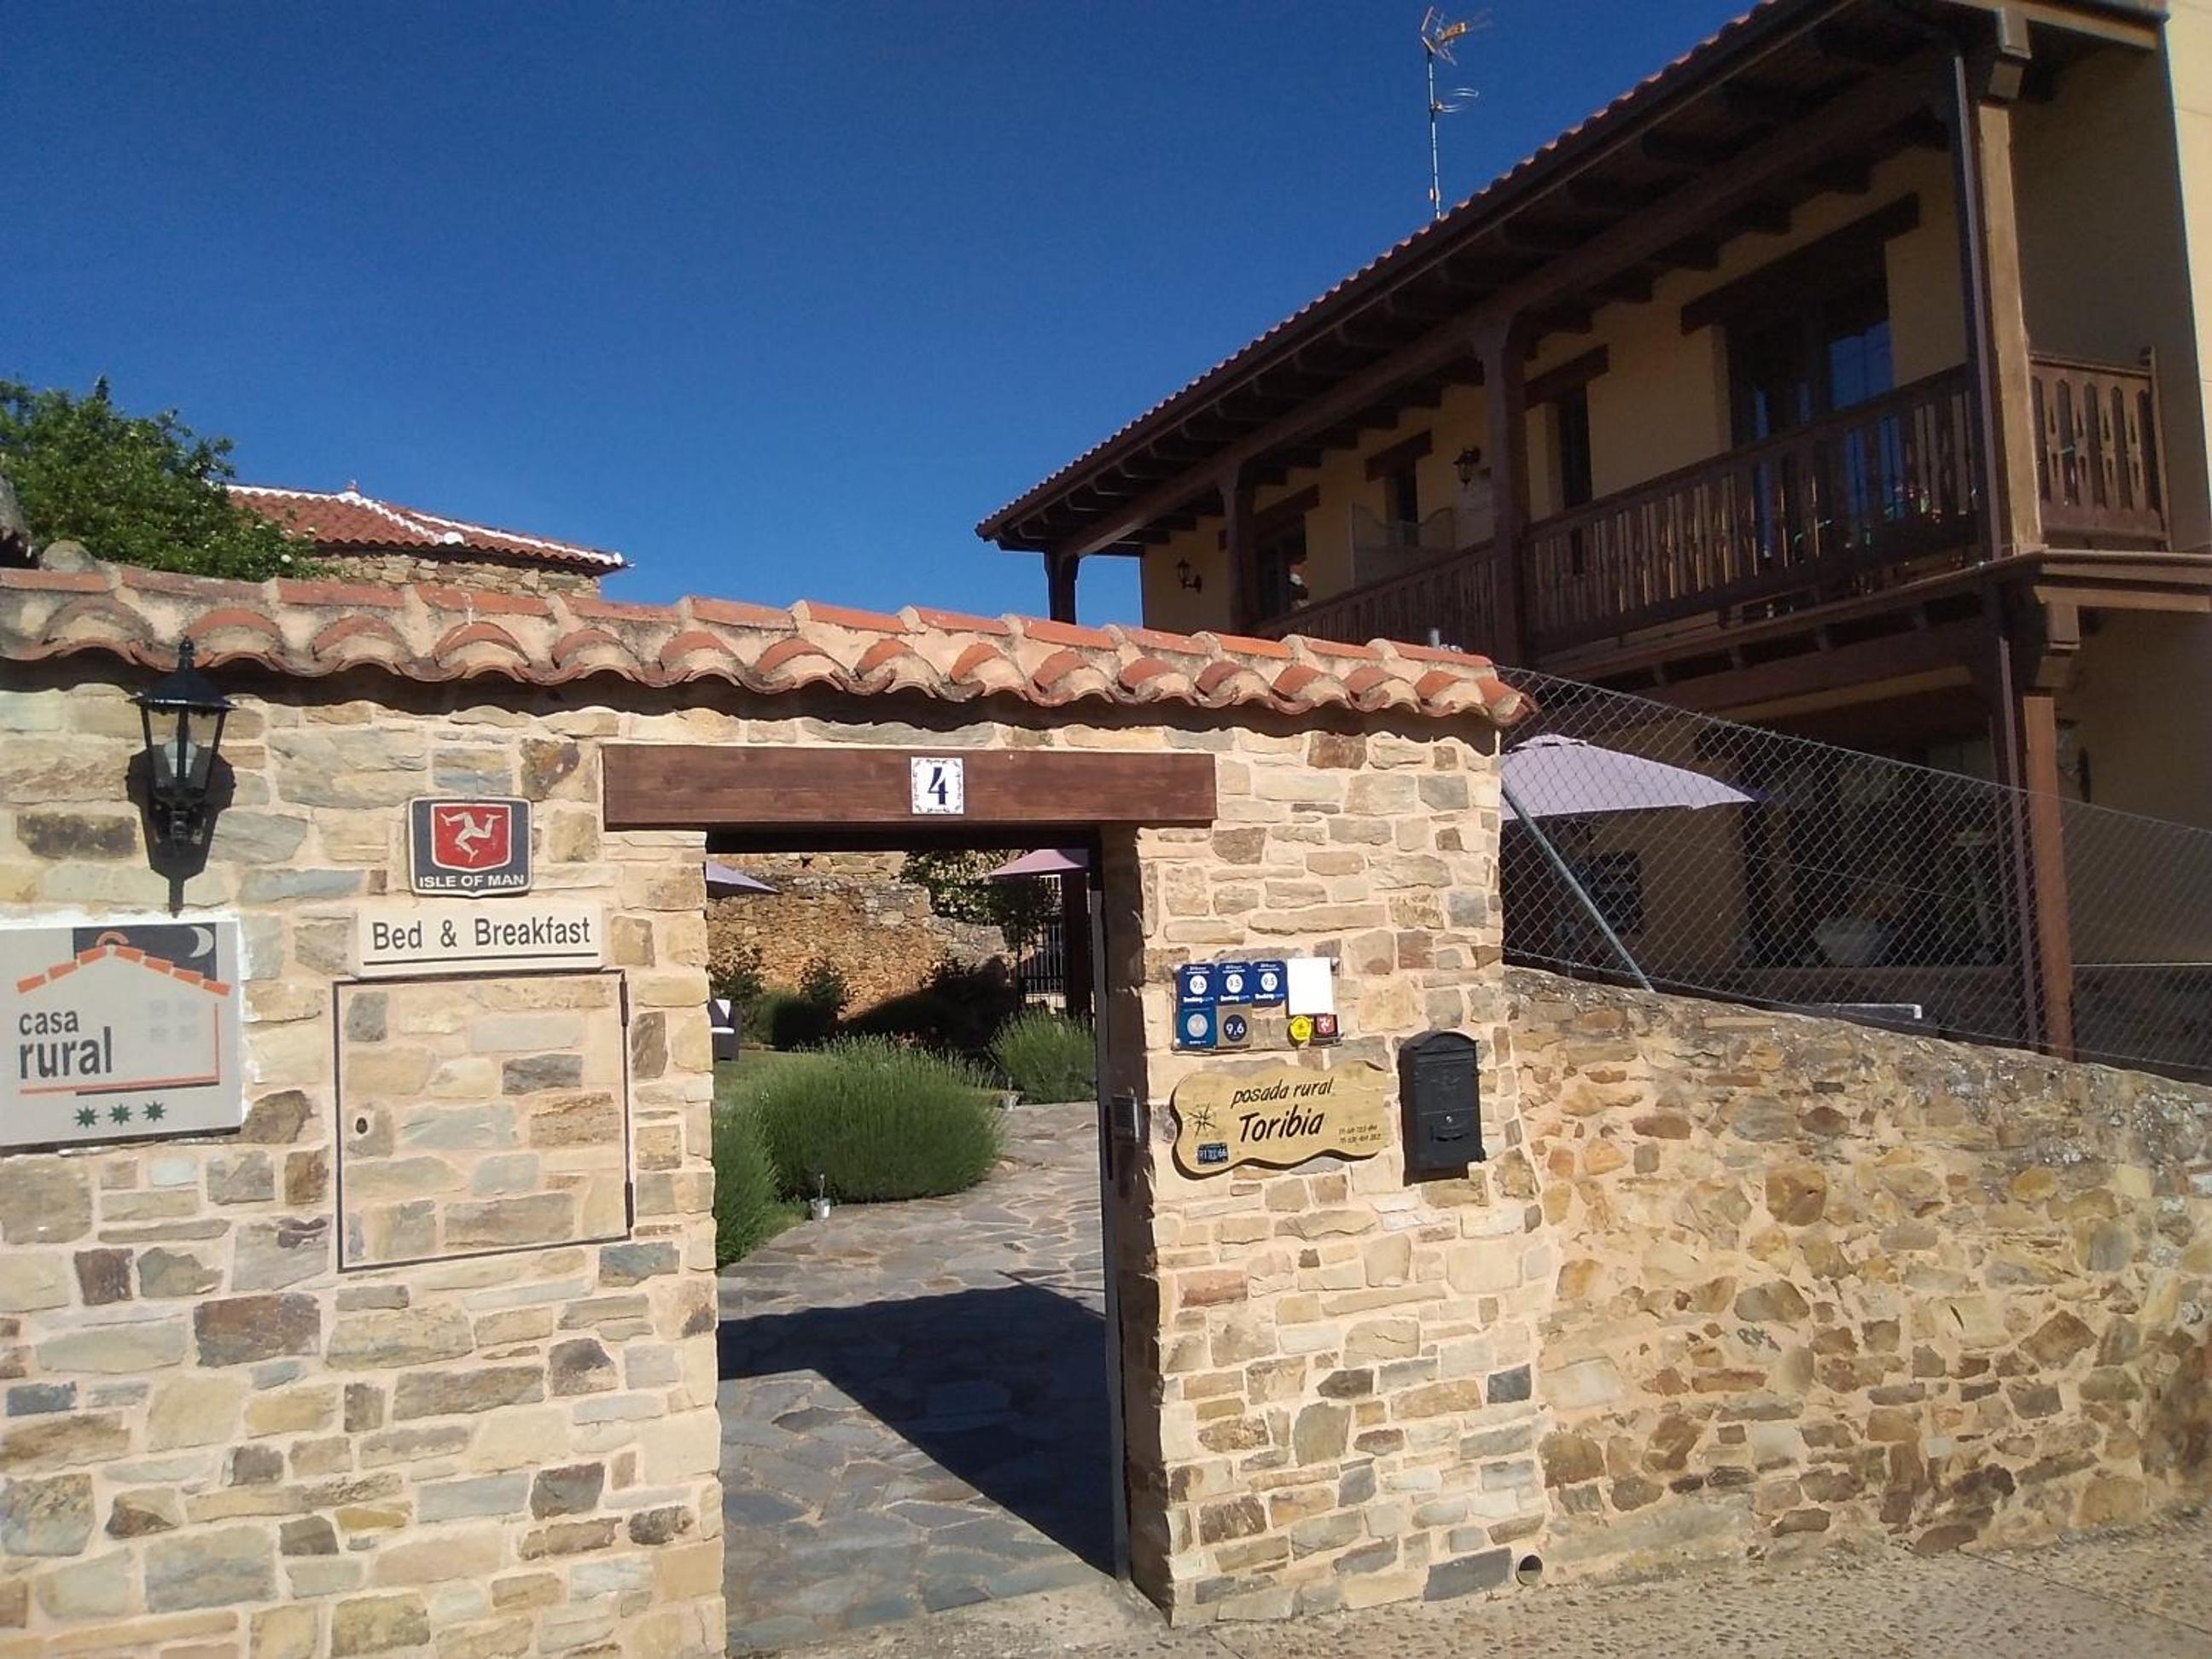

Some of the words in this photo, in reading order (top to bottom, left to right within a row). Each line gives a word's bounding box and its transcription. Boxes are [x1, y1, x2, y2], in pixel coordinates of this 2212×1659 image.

[927, 766, 949, 806] 4
[419, 876, 457, 888] ISLE
[461, 875, 484, 888] OF
[487, 873, 525, 887] MAN
[372, 920, 422, 951] Bed
[439, 919, 457, 948] &
[474, 916, 591, 946] Breakfast
[19, 1010, 79, 1035] casa
[1225, 1023, 1244, 1036] 9,6
[20, 1026, 113, 1080] rural
[1229, 1078, 1290, 1109] posada
[1293, 1077, 1334, 1098] rural
[1239, 1103, 1325, 1143] Toribia
